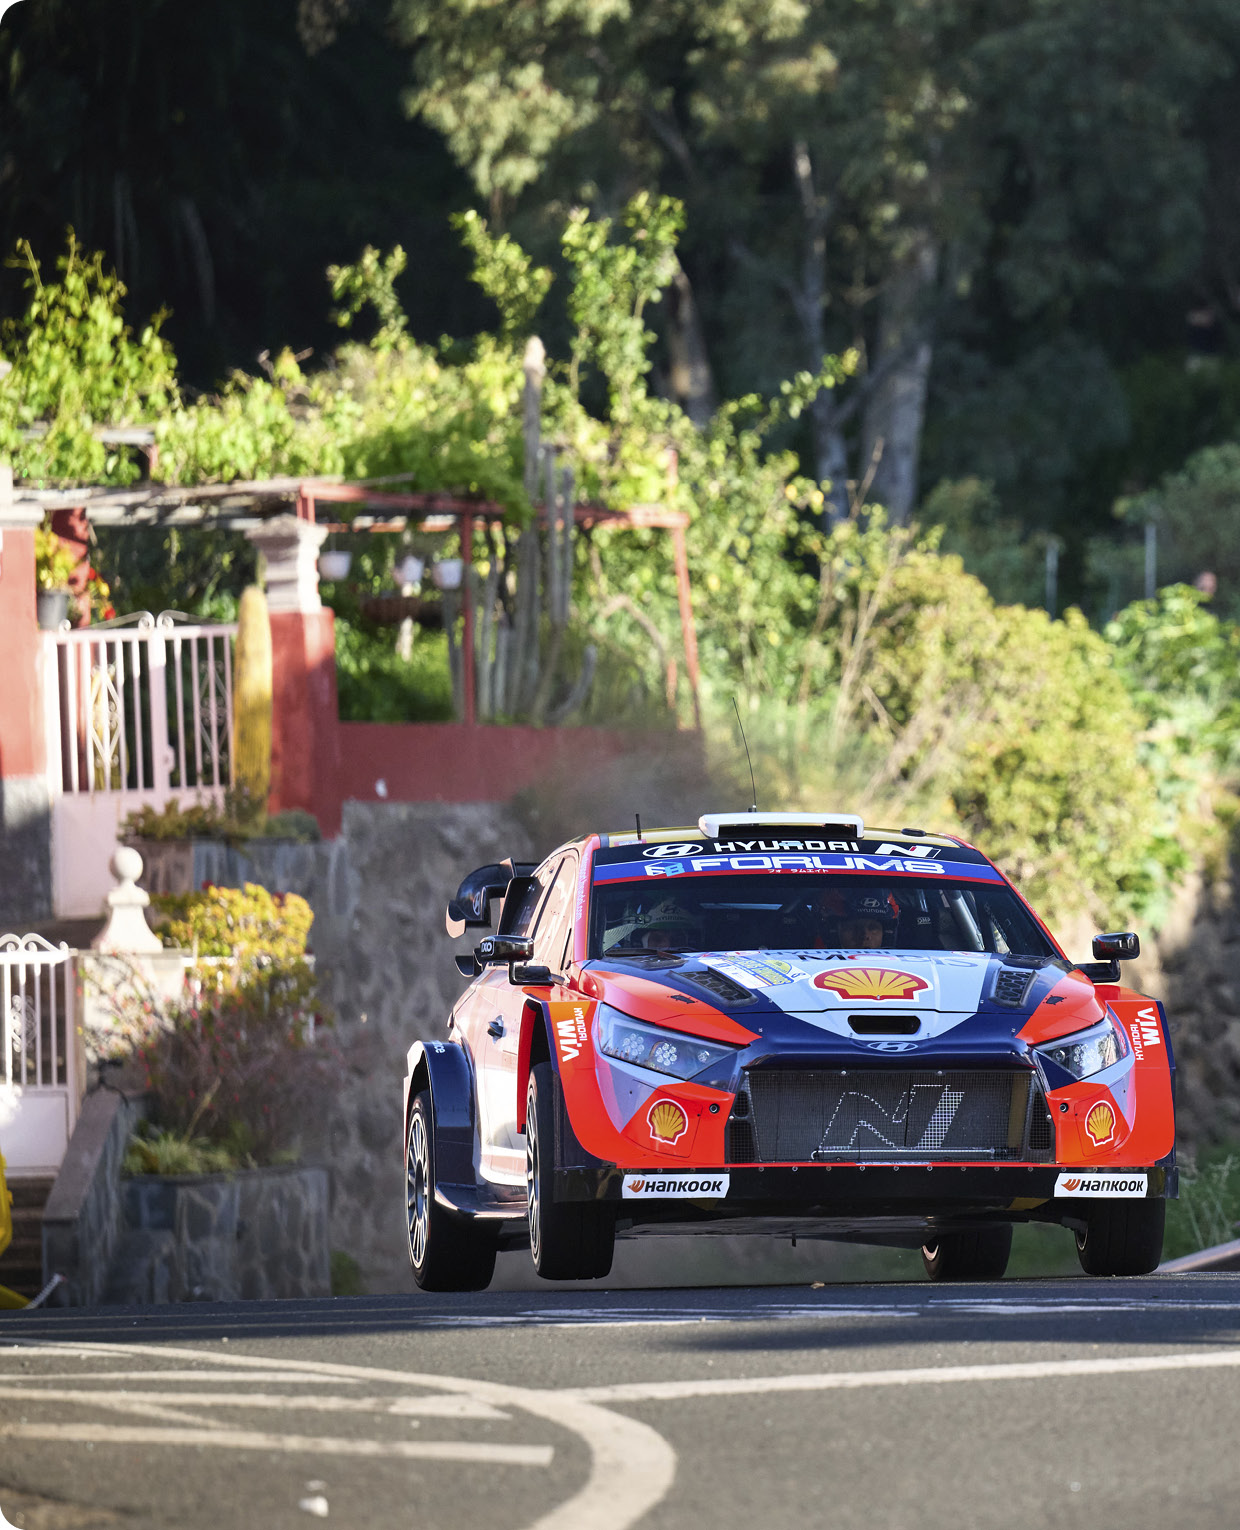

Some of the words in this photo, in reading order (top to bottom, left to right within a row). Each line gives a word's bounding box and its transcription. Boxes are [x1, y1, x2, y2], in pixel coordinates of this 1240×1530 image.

[714, 840, 859, 852] HYUNDAI
[691, 856, 945, 874] FORUM8
[556, 1019, 582, 1063] WIA
[573, 1007, 588, 1041] HYUNDAI
[1132, 1007, 1161, 1047] WIA
[1130, 1024, 1145, 1061] HYUNDAI
